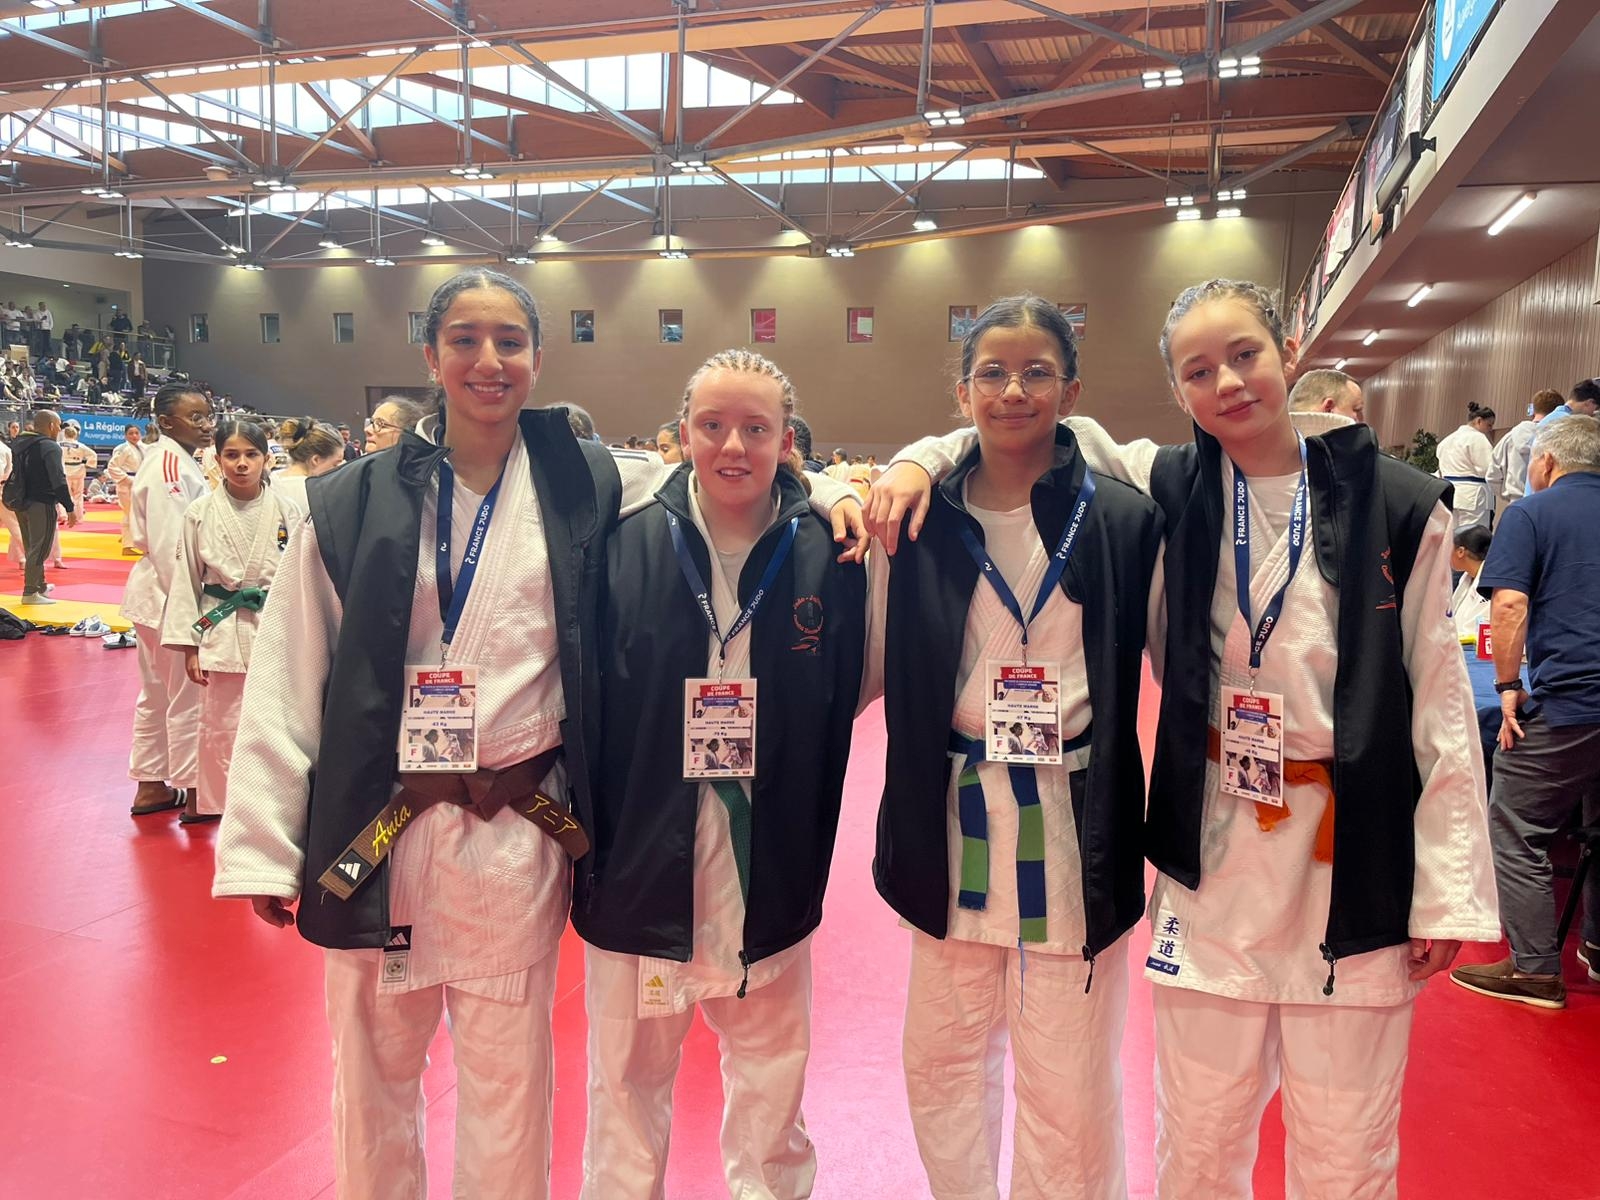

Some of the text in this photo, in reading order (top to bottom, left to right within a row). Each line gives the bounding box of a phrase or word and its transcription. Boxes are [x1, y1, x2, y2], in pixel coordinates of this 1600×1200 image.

[84, 421, 126, 432] La Région
[469, 504, 490, 557] FRANCE JUDO
[1061, 501, 1087, 553] FRANCE JUDO
[1237, 505, 1246, 538] FRANCE
[1293, 523, 1302, 547] JUDO
[701, 600, 717, 630] FRANCE
[731, 589, 764, 636] FRANCE JUDO
[1258, 616, 1274, 642] JUDO
[410, 748, 417, 756] F
[996, 740, 1003, 748] F
[1228, 772, 1234, 780] F
[526, 794, 578, 834] アニア
[372, 804, 412, 857] Ania
[1157, 916, 1180, 958] 柔道
